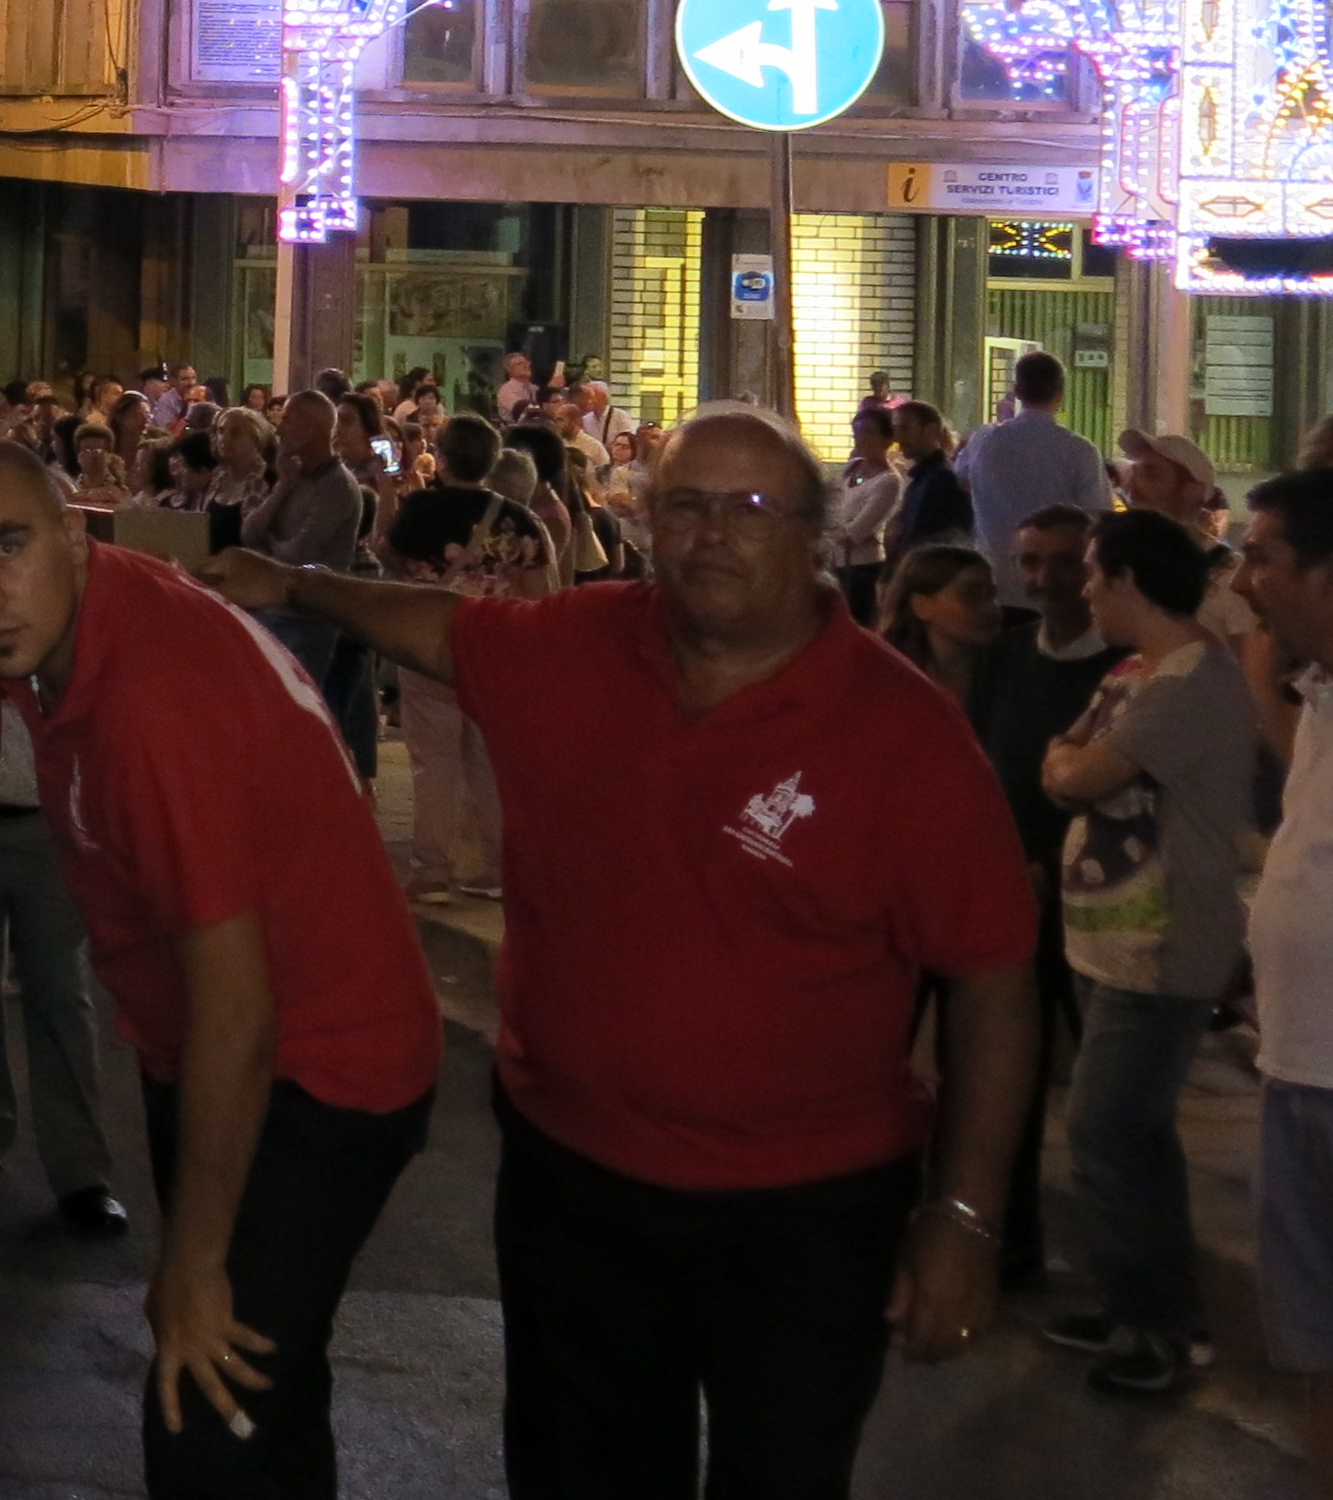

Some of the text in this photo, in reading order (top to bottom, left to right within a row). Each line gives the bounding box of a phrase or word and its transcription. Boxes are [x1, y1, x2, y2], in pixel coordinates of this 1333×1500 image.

[978, 172, 1028, 182] CENTRO
[946, 185, 1059, 196] SERVIZI TURISTICI
